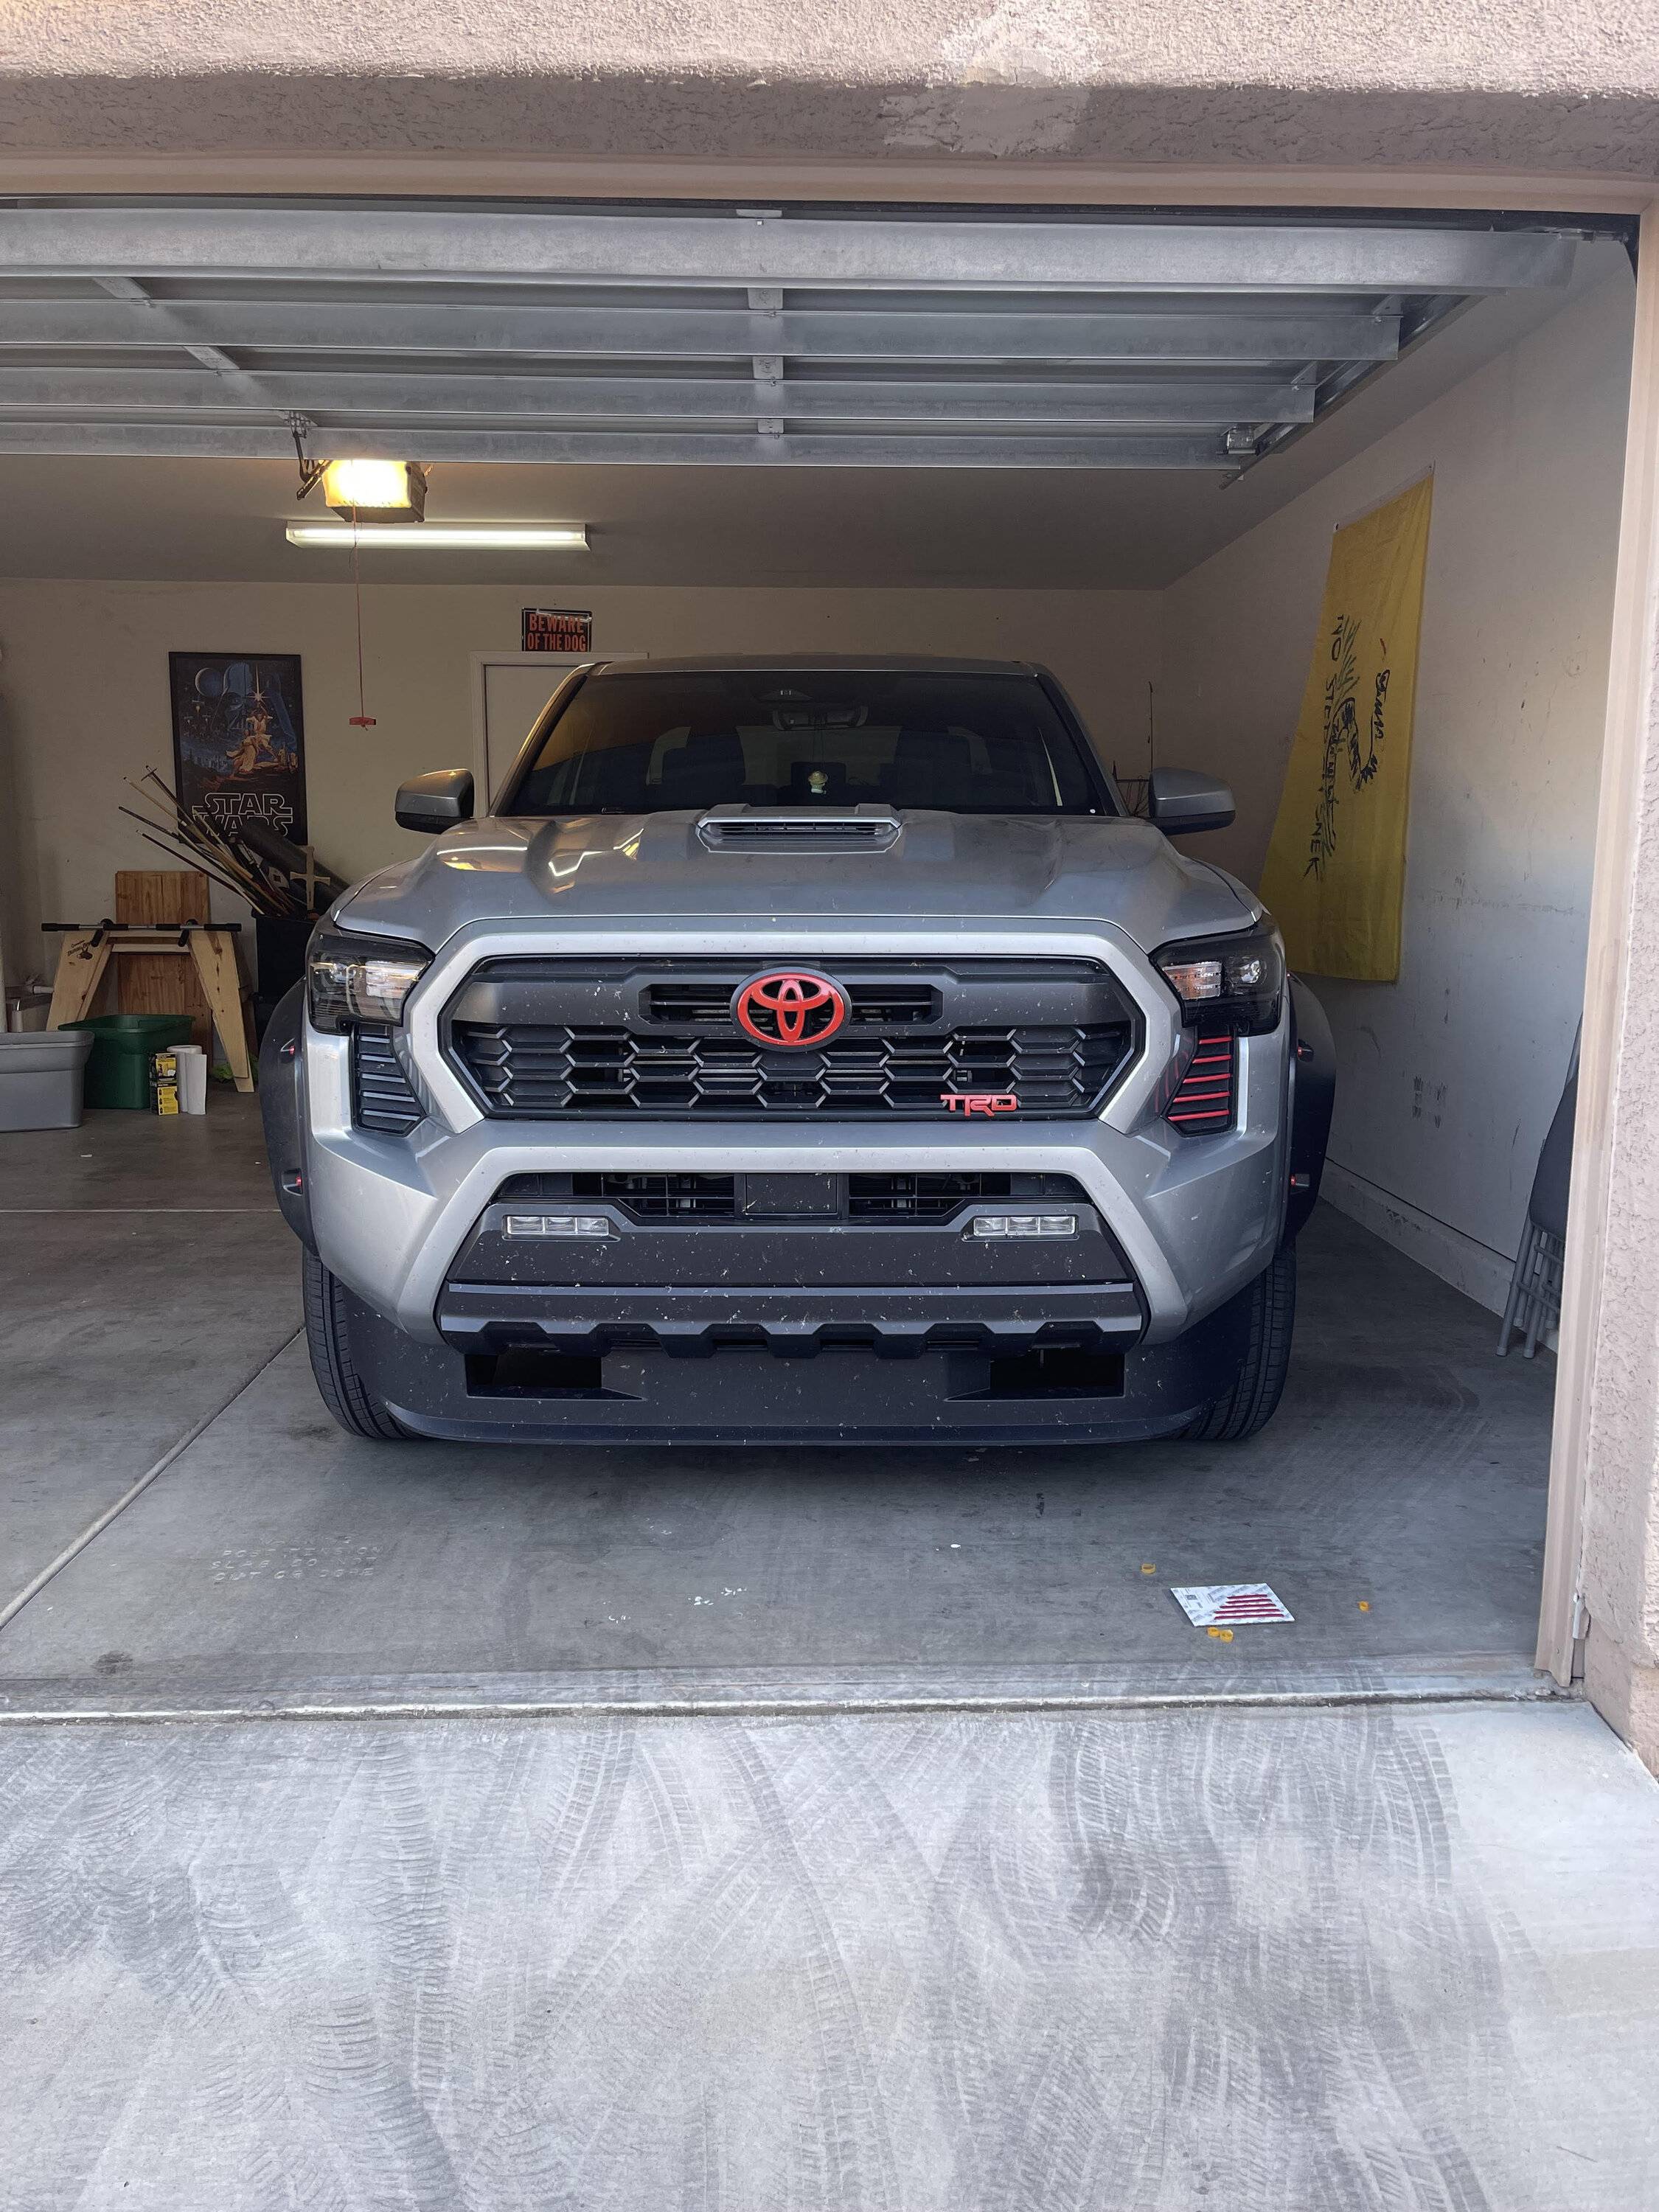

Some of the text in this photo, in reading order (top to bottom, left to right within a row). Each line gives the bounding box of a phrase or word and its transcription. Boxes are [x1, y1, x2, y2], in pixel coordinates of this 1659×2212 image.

[529, 613, 584, 633] BEWARE
[527, 633, 586, 652] OF THE DOG
[192, 792, 293, 815] STAR
[1302, 803, 1322, 882] SNEK
[940, 1094, 1017, 1116] TRD
